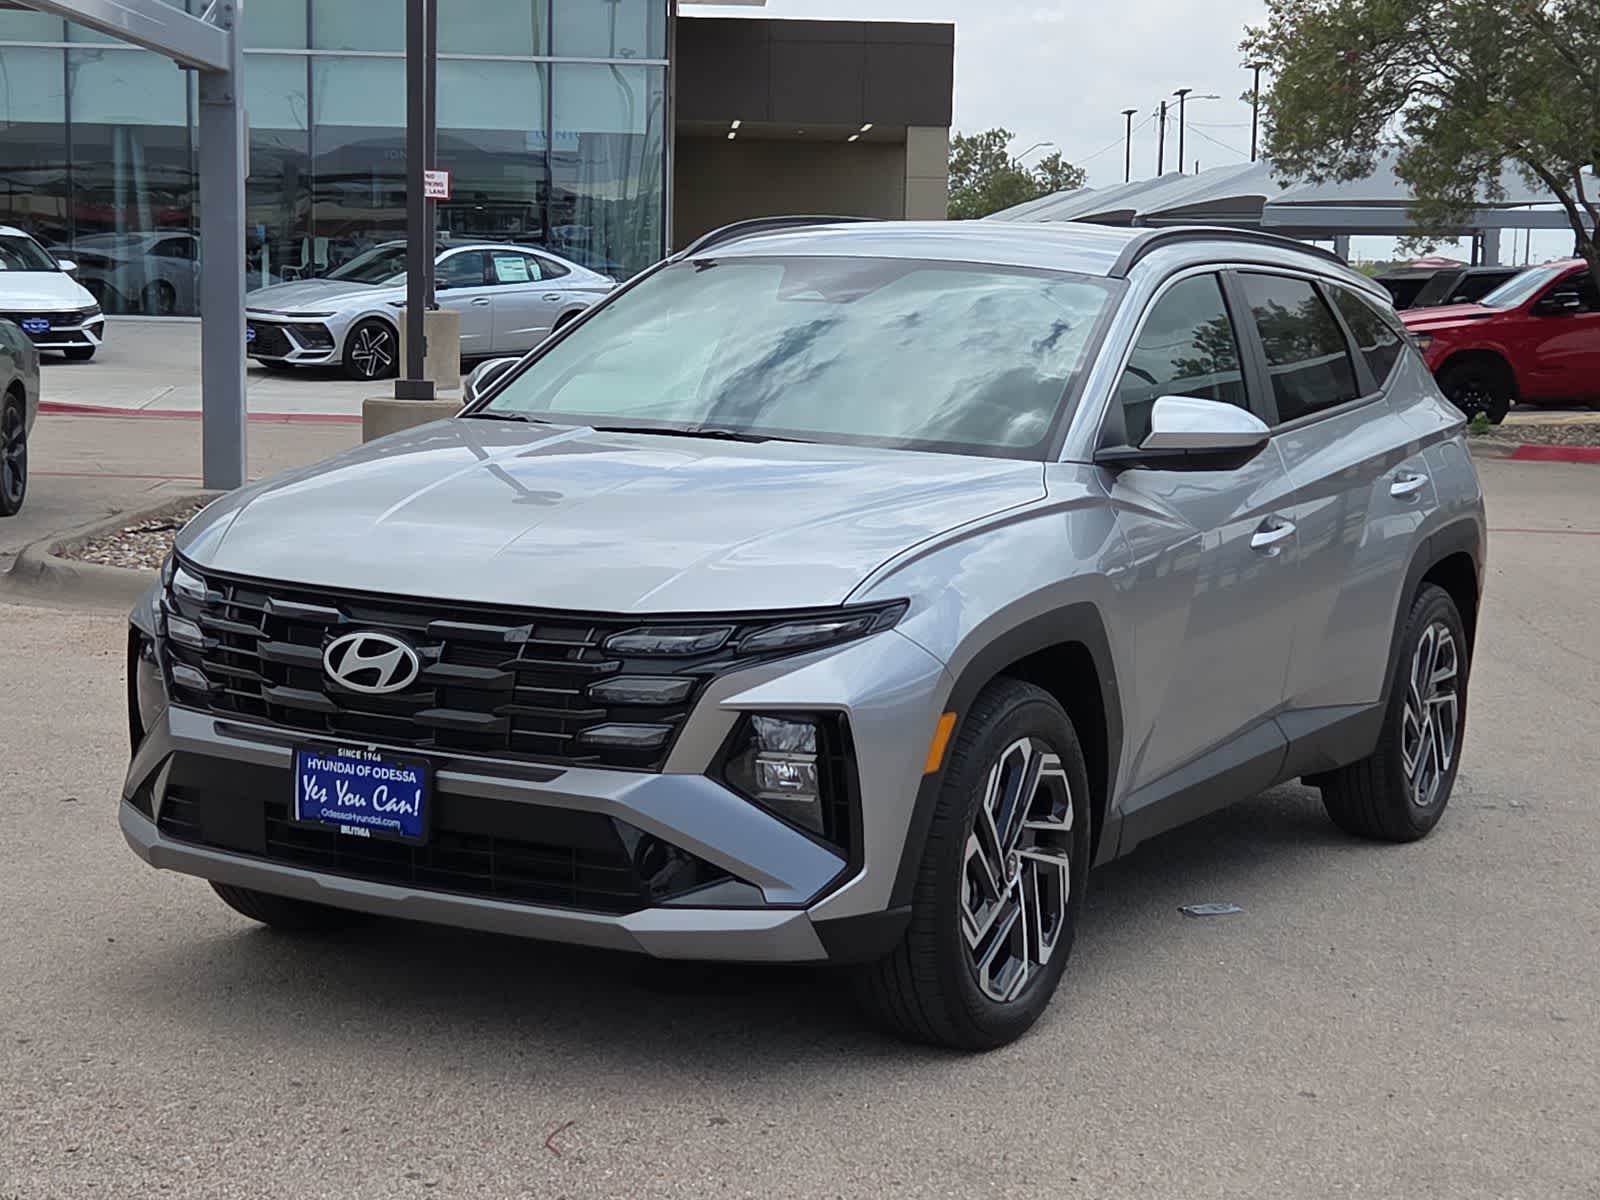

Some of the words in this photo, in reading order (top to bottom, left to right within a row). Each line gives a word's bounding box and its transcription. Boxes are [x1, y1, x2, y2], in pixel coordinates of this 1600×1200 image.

[338, 748, 361, 760] SINCE
[307, 757, 355, 775] HYUNDAI
[356, 765, 372, 777] OF
[372, 767, 417, 784] ODESSA
[302, 774, 328, 803] Yes
[335, 779, 367, 807] You
[372, 785, 422, 817] Can!
[320, 807, 401, 829] OdessaHyundai.com
